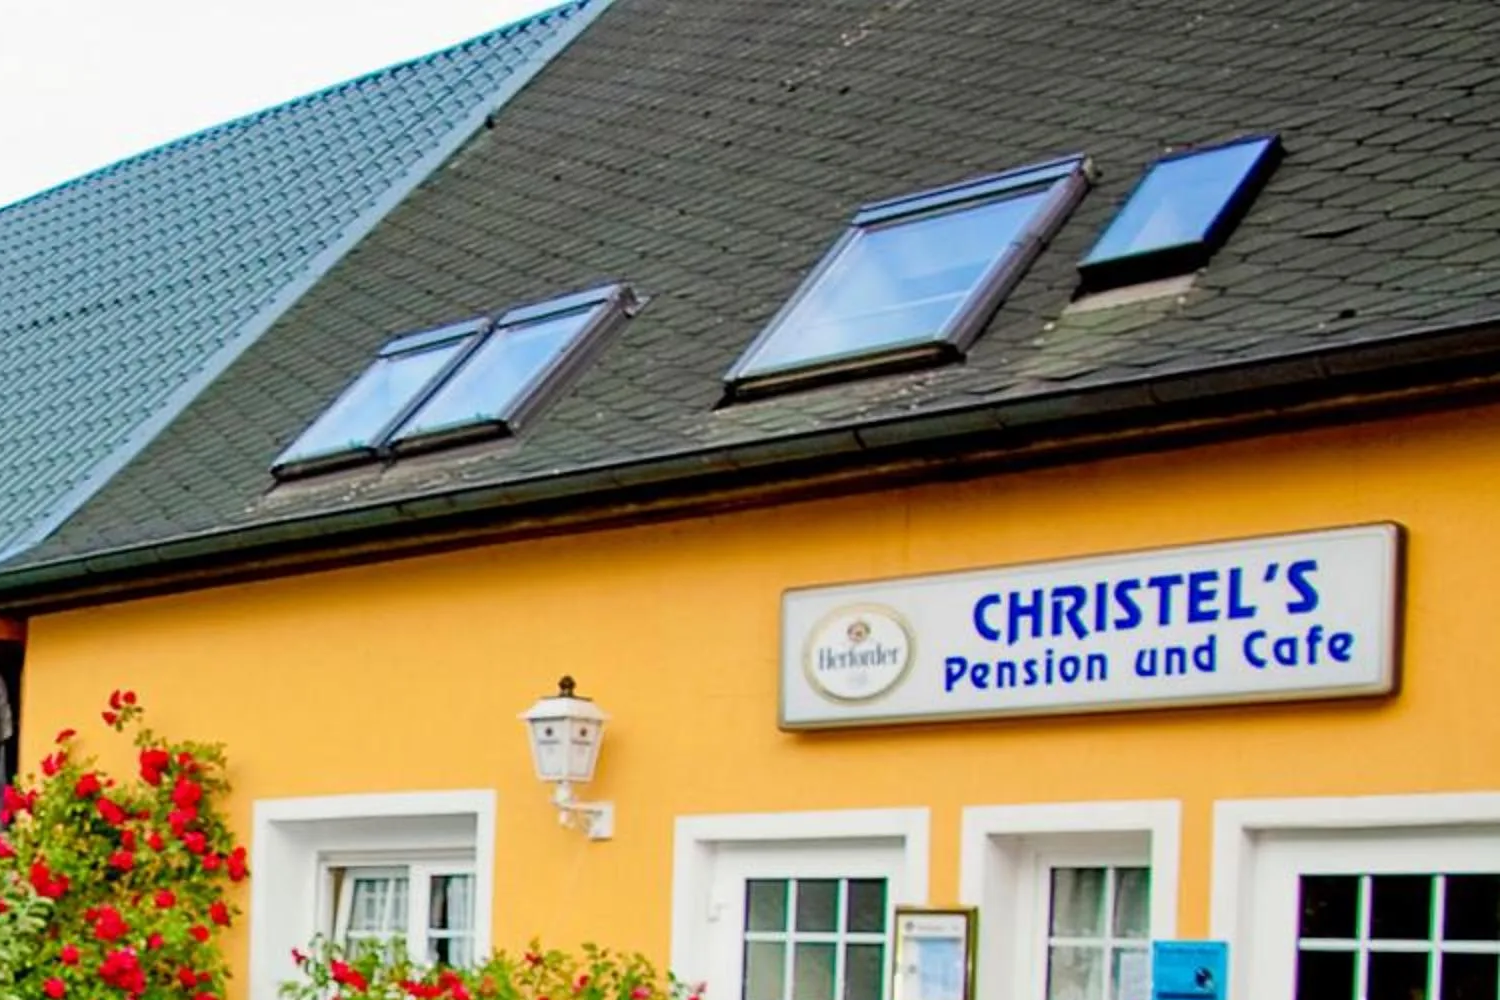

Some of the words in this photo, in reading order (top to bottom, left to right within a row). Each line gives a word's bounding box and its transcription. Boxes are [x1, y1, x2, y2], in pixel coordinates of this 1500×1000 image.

[973, 559, 1320, 646] CHRISTEL'S
[944, 648, 1109, 693] Pension
[1134, 634, 1218, 678] und
[1242, 624, 1356, 669] Cafe
